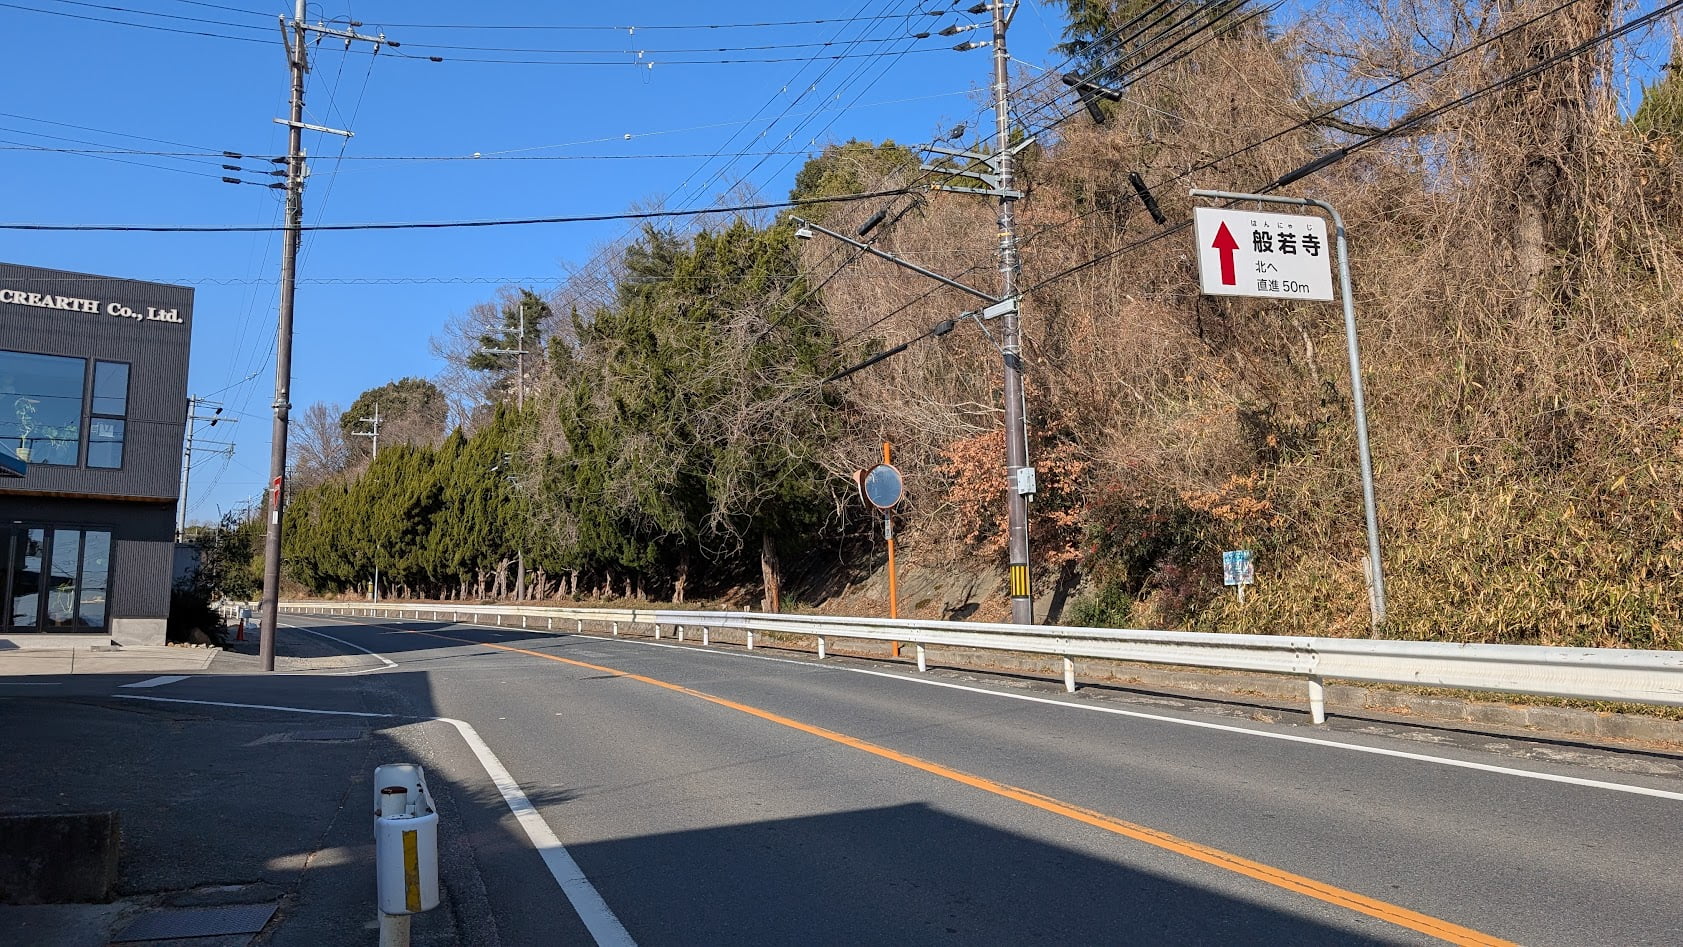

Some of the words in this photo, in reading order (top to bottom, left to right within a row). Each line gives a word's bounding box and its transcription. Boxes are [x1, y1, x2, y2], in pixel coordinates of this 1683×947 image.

[1252, 230, 1321, 257] 般若寺
[1255, 260, 1278, 273] 北へ
[0, 289, 100, 314] CREARTH
[107, 302, 143, 321] Co.,
[146, 307, 183, 323] Ltd.
